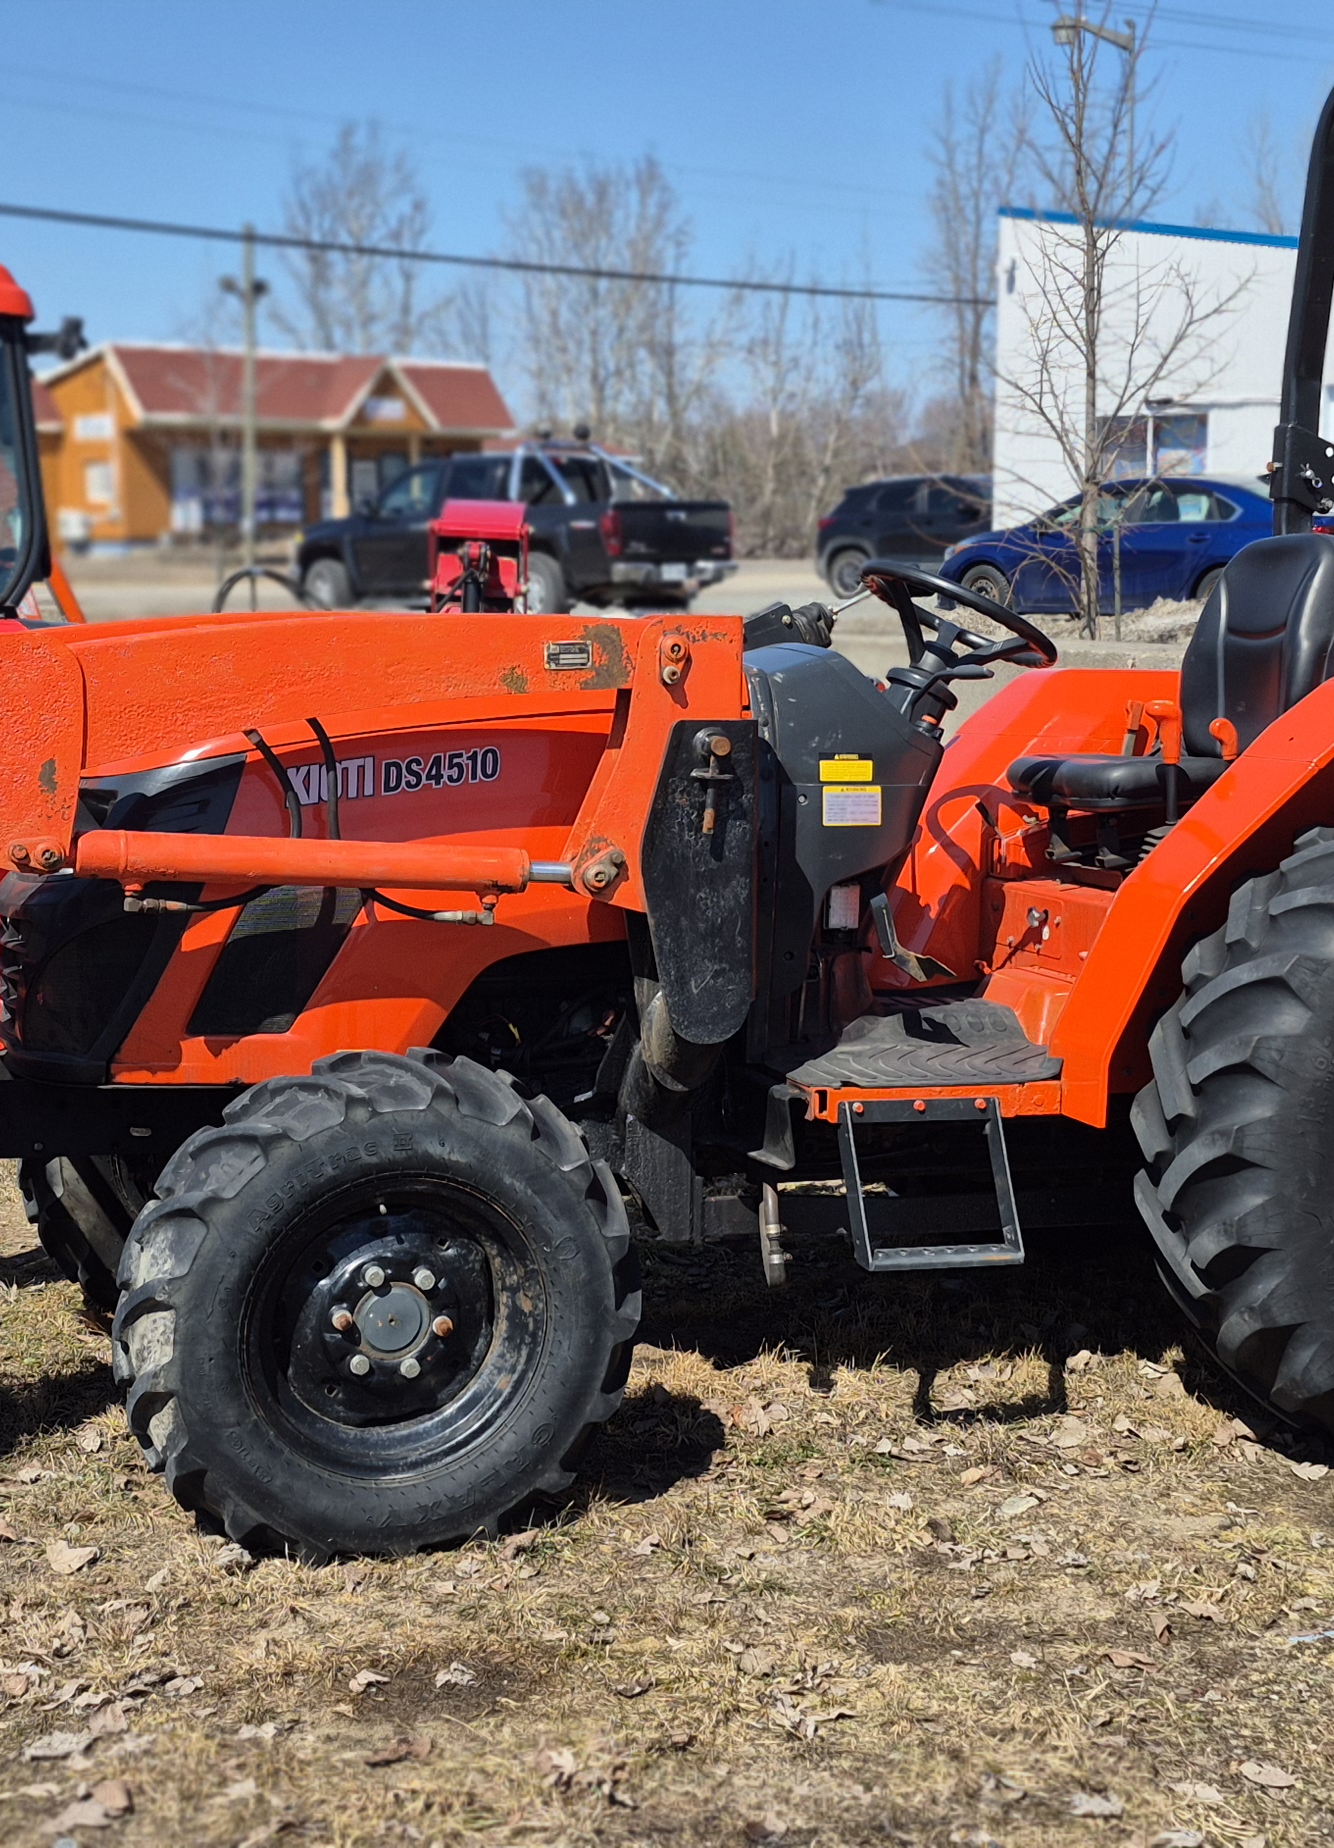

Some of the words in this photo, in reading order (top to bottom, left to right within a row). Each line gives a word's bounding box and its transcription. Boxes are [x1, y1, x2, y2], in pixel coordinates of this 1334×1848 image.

[285, 755, 375, 808] KIOTI
[382, 745, 501, 796] DS4510
[376, 1422, 555, 1529] GALAXY
